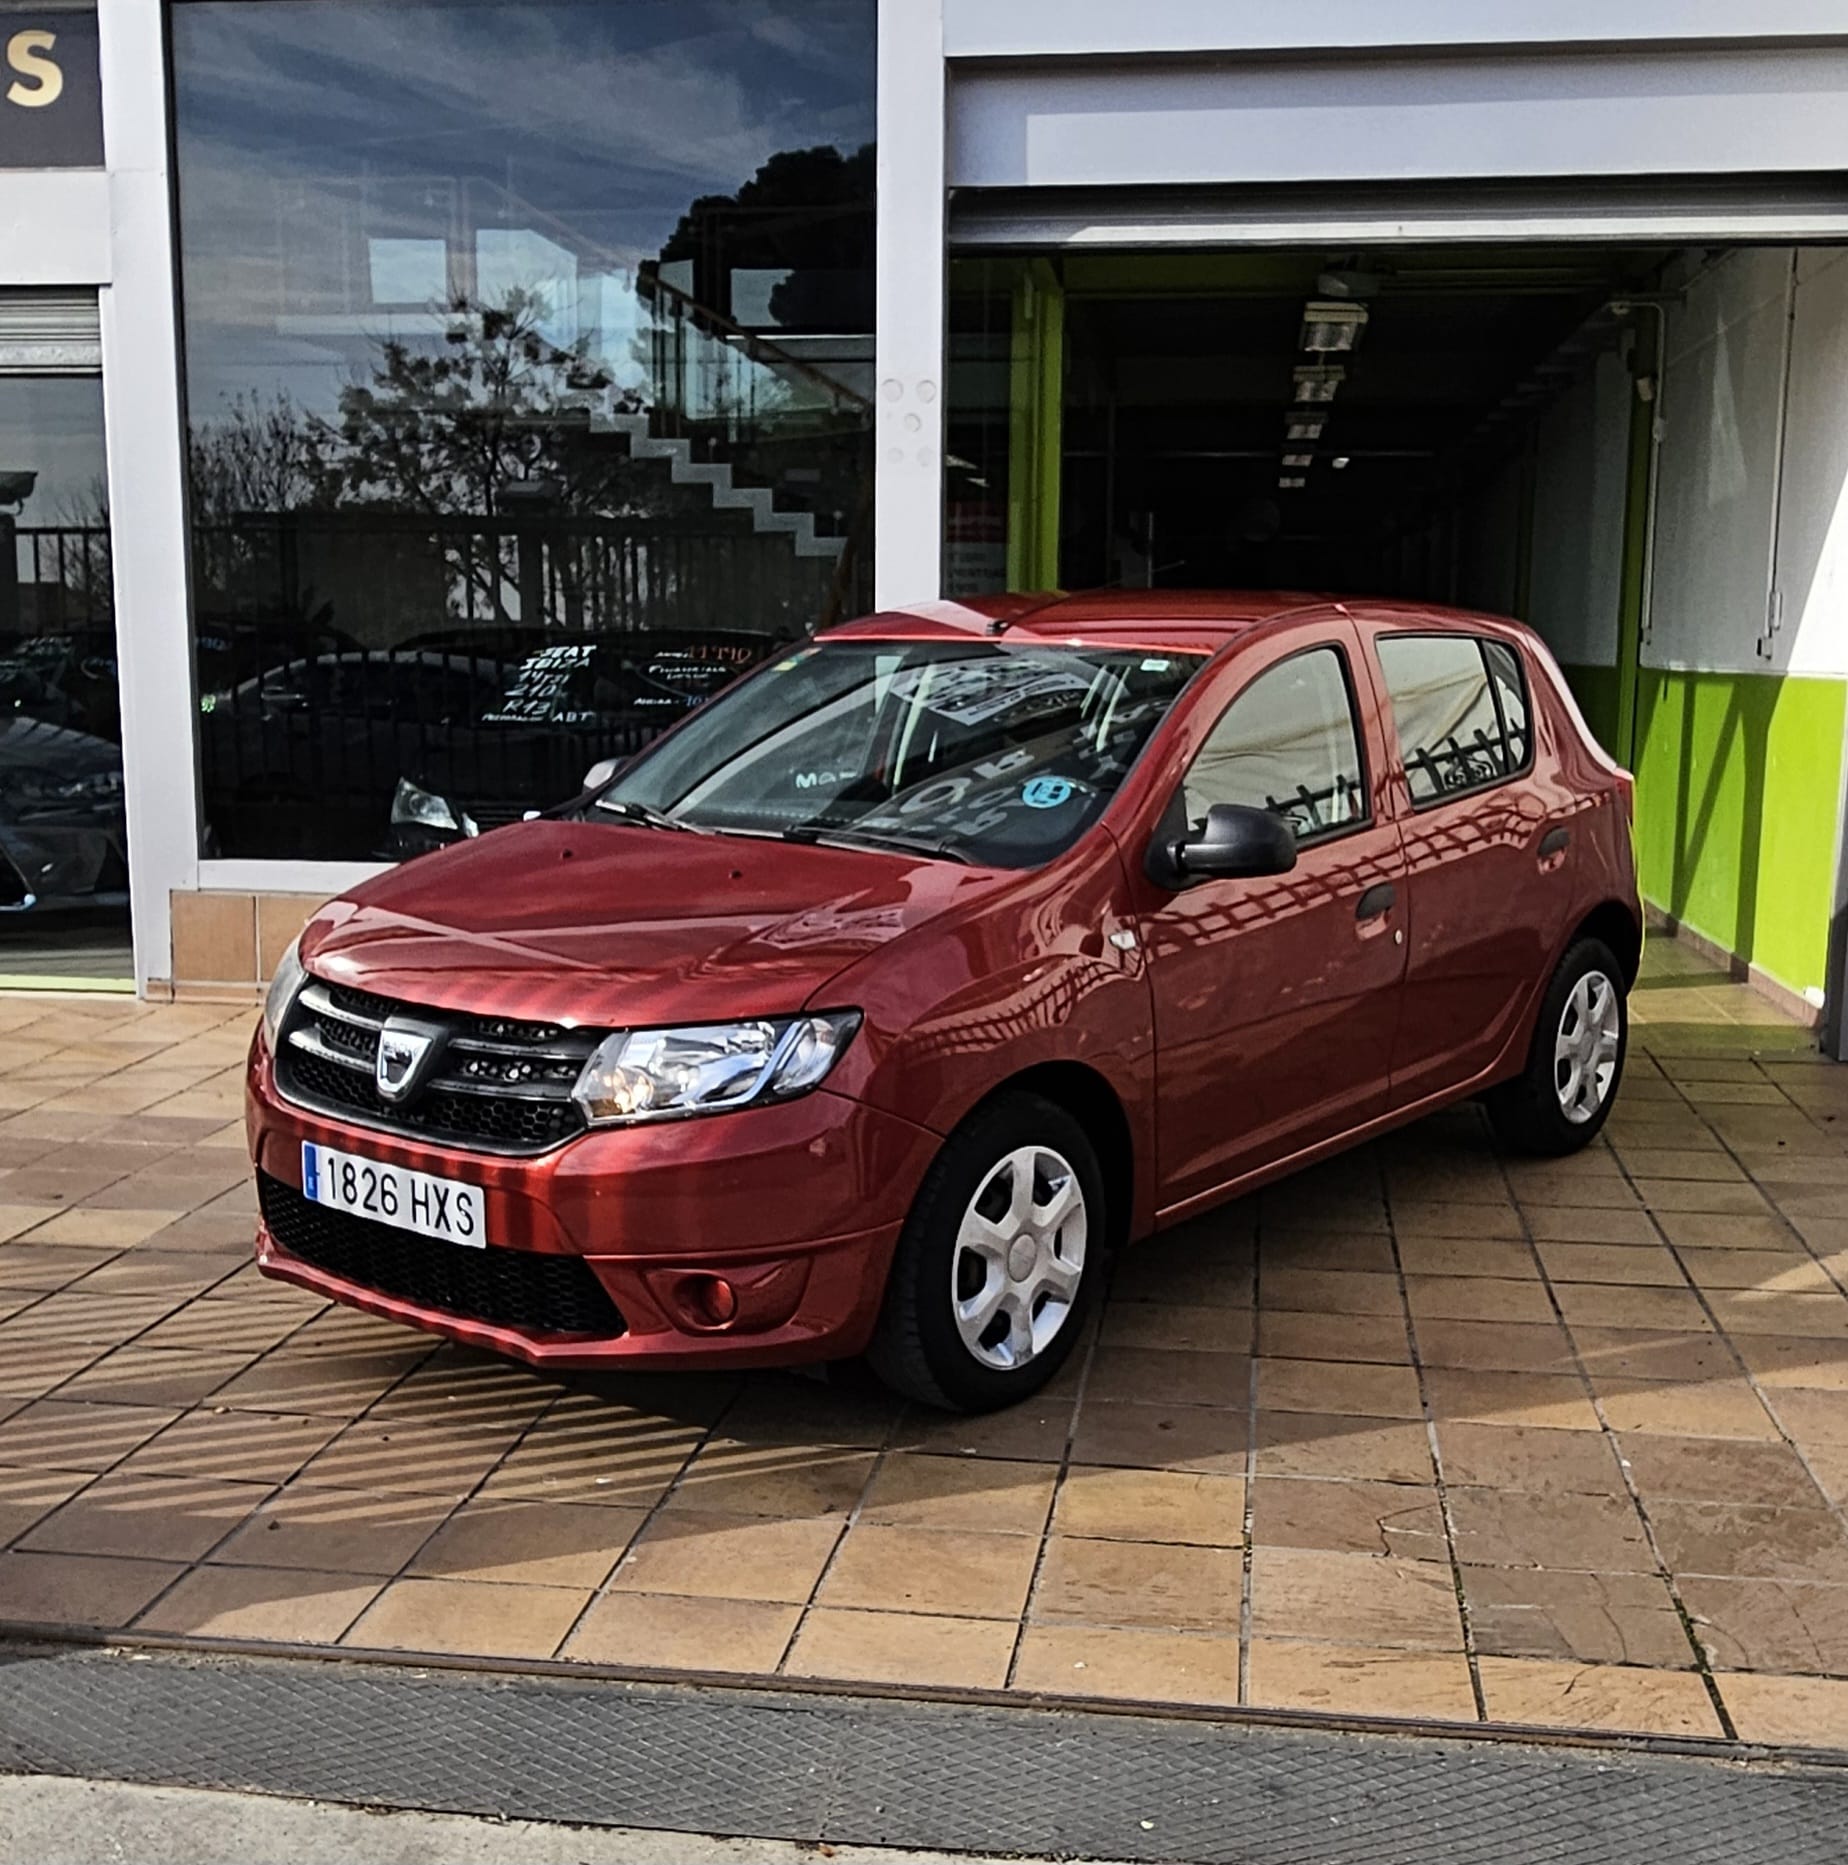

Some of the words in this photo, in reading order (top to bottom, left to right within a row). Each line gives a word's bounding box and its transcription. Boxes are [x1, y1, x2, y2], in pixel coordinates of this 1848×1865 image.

[6, 29, 63, 107] S
[540, 645, 597, 658] SEAT
[327, 1157, 398, 1216] 1826
[410, 1177, 474, 1236] HXS
